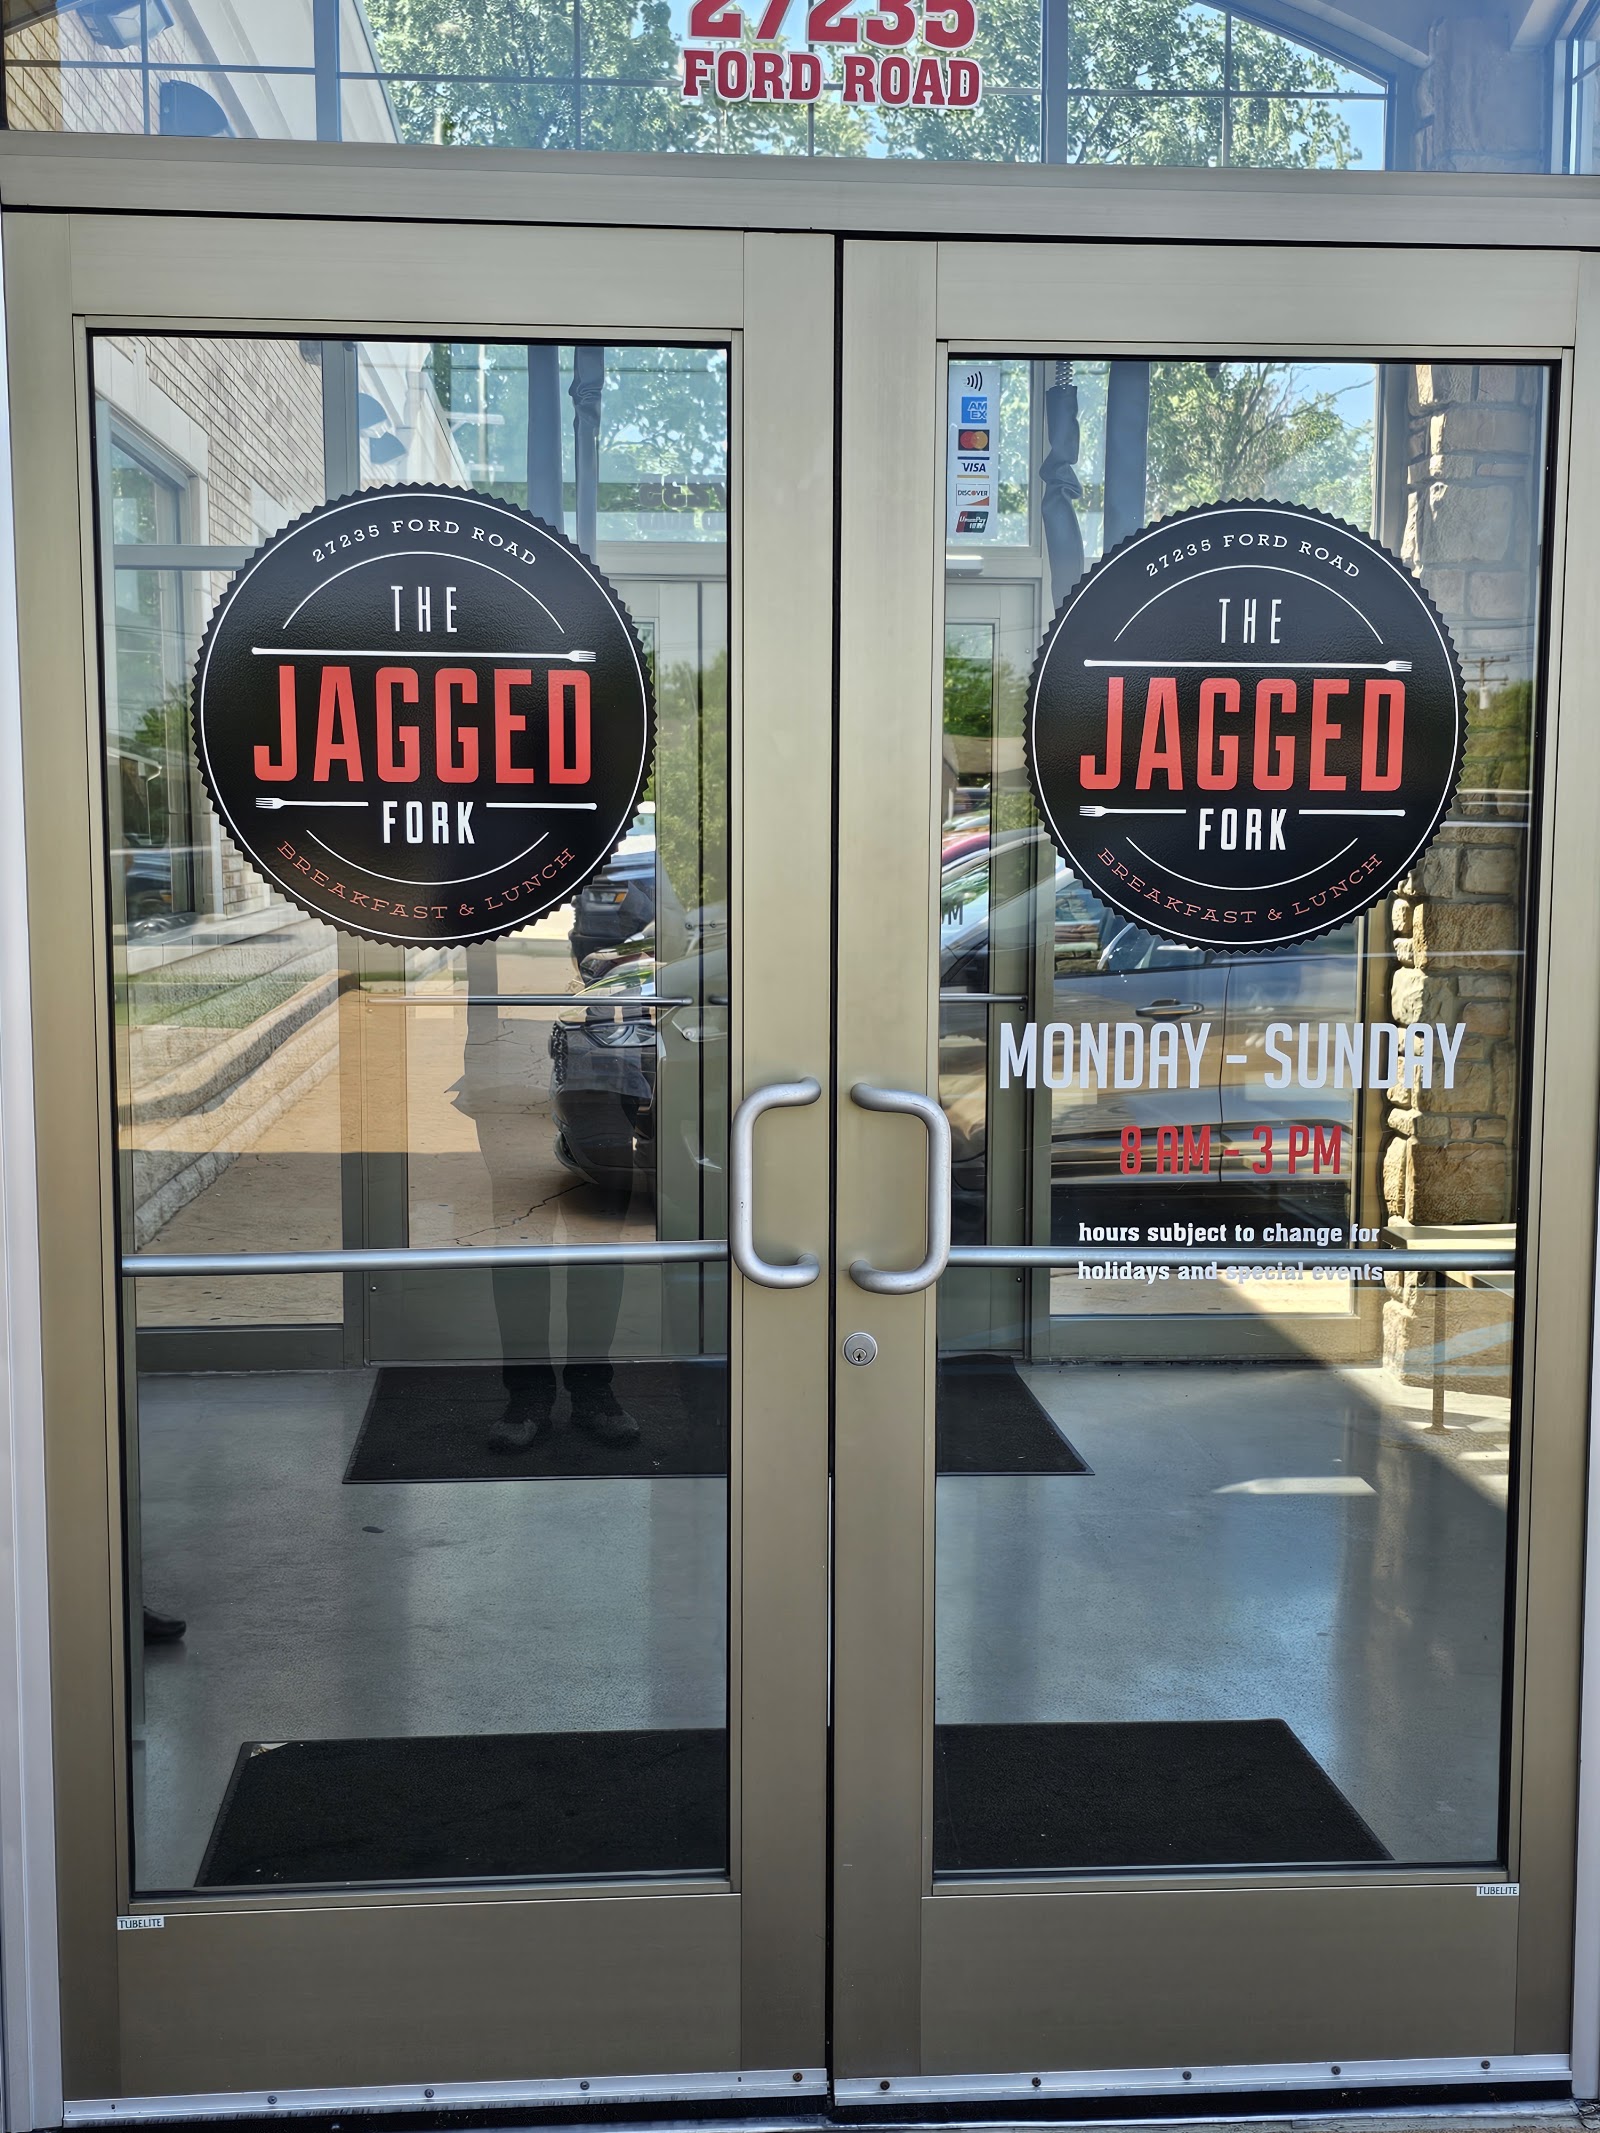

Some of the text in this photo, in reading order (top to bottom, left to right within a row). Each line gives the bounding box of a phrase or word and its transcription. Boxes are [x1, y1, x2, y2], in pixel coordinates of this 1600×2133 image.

[682, 48, 982, 108] FORD ROAD
[962, 463, 986, 472] VISA
[312, 519, 536, 565] 27235 FORD ROAD
[1146, 533, 1360, 577] 27235 FORD ROAD
[391, 585, 457, 632] THE
[1219, 598, 1282, 644] THE
[253, 665, 592, 784] JAGGED
[1079, 677, 1406, 792] JAGGED
[383, 801, 475, 844] FORK
[1198, 808, 1287, 850] FORK
[277, 840, 576, 919] BREAKFAST & LUNCH
[1097, 848, 1382, 923] BREAKFAST & LUNCH
[999, 1022, 1211, 1089] MONDAY
[1264, 1022, 1466, 1089] SUNDAY
[1120, 1125, 1142, 1175] 8
[1156, 1125, 1211, 1175] AM
[1252, 1125, 1273, 1175] 3
[1288, 1125, 1341, 1175] PM
[1078, 1222, 1380, 1246] hours subject to change for
[1077, 1261, 1384, 1285] holidays and special events
[1479, 1886, 1518, 1895] TUBELITE
[119, 1918, 162, 1929] TUBELITE
